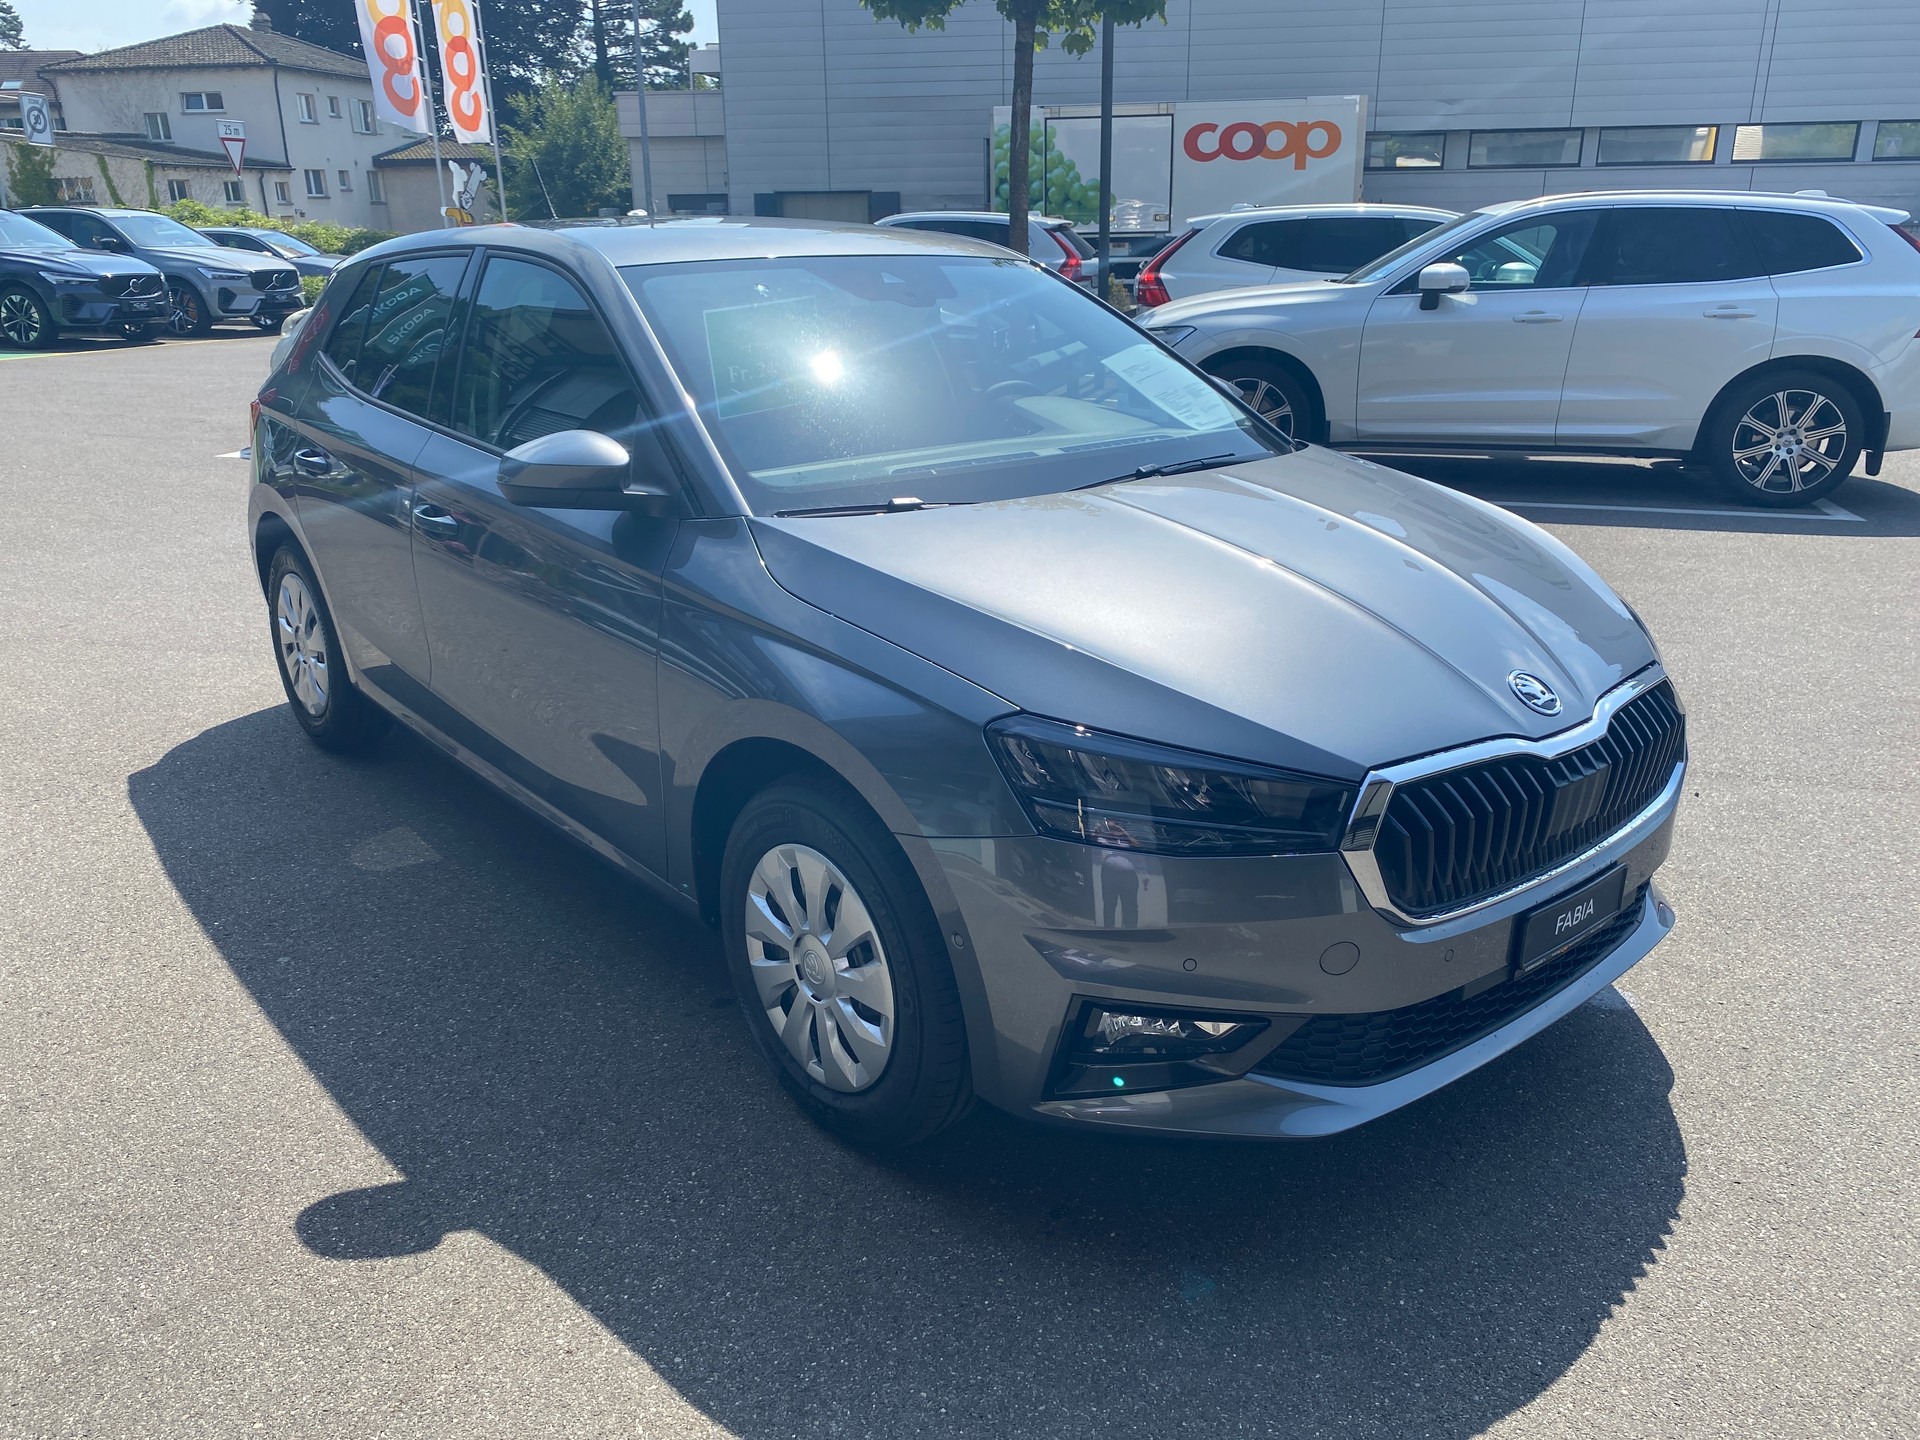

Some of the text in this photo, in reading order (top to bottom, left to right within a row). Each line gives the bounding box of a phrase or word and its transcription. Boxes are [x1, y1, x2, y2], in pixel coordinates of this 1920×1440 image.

[432, 0, 482, 132] coo
[224, 125, 232, 135] 25
[1183, 120, 1342, 170] coop
[728, 365, 752, 383] Fr.
[1555, 898, 1594, 935] FABIA
